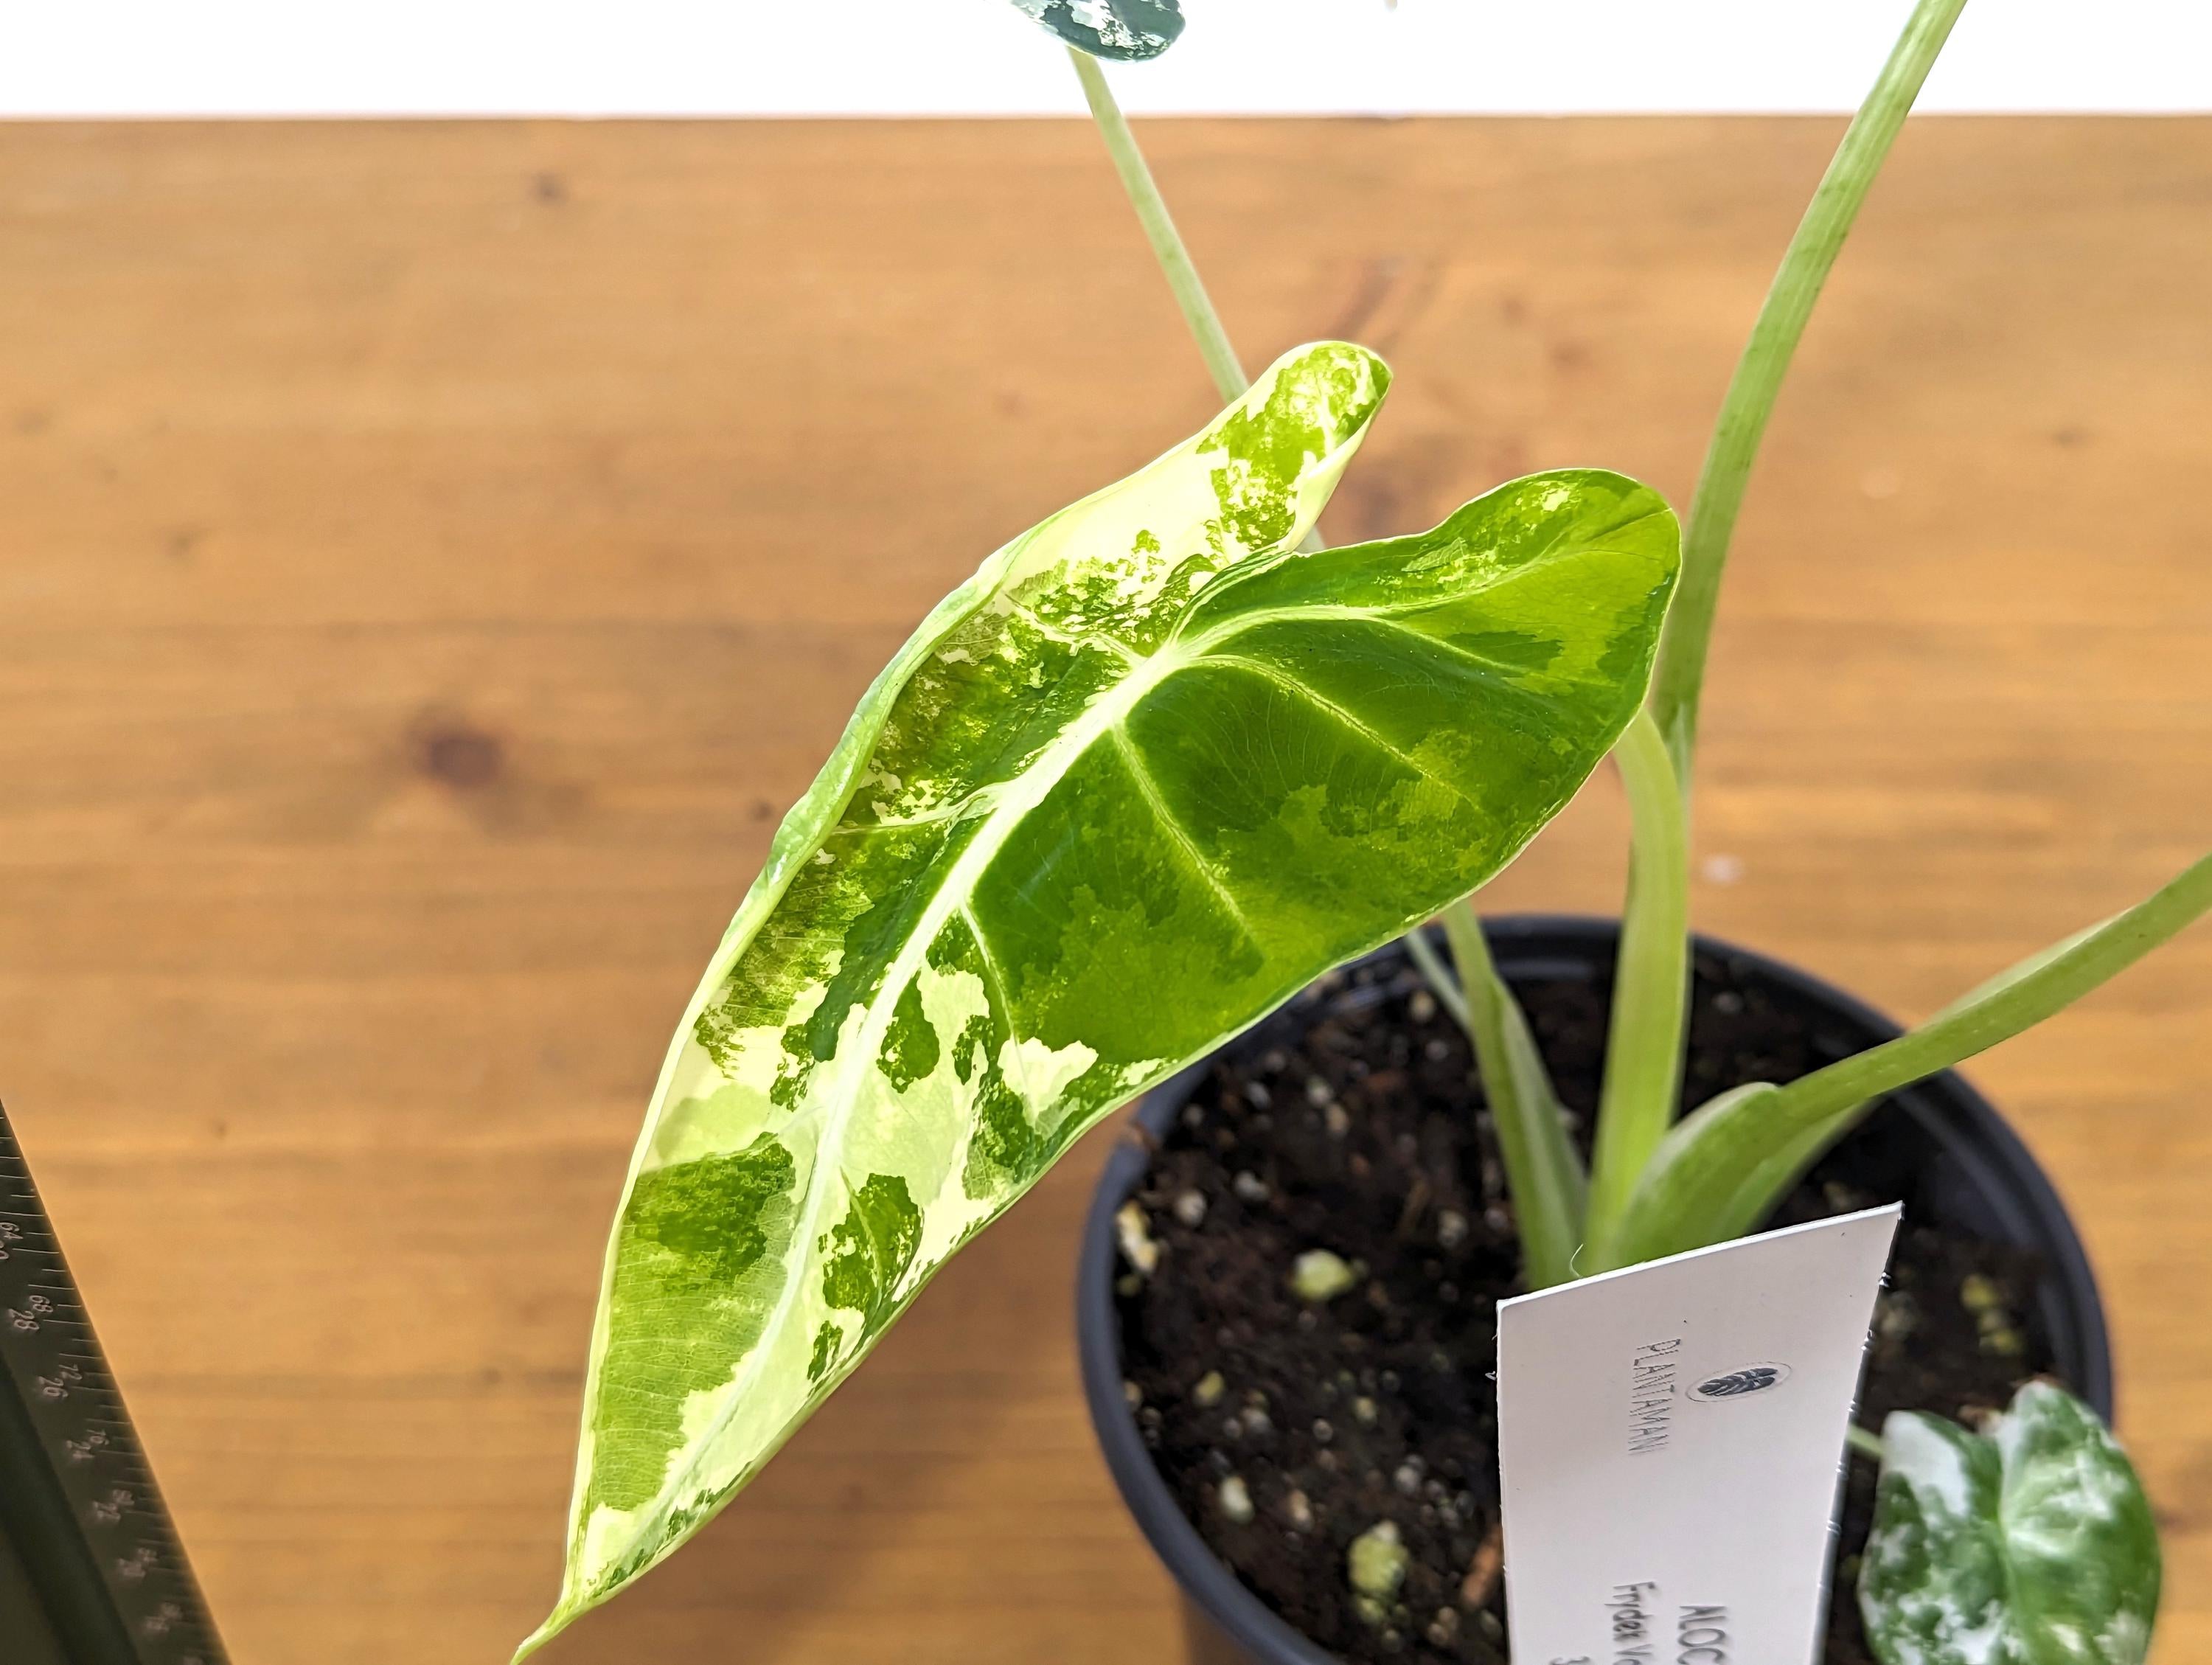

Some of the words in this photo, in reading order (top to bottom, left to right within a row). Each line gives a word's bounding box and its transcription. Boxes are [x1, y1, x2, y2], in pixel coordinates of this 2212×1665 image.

[7, 1308, 40, 1330] 28
[38, 1375, 69, 1398] 26
[29, 1295, 54, 1313] 68
[58, 1364, 83, 1380] 72
[1604, 1580, 1657, 1641] Frydek
